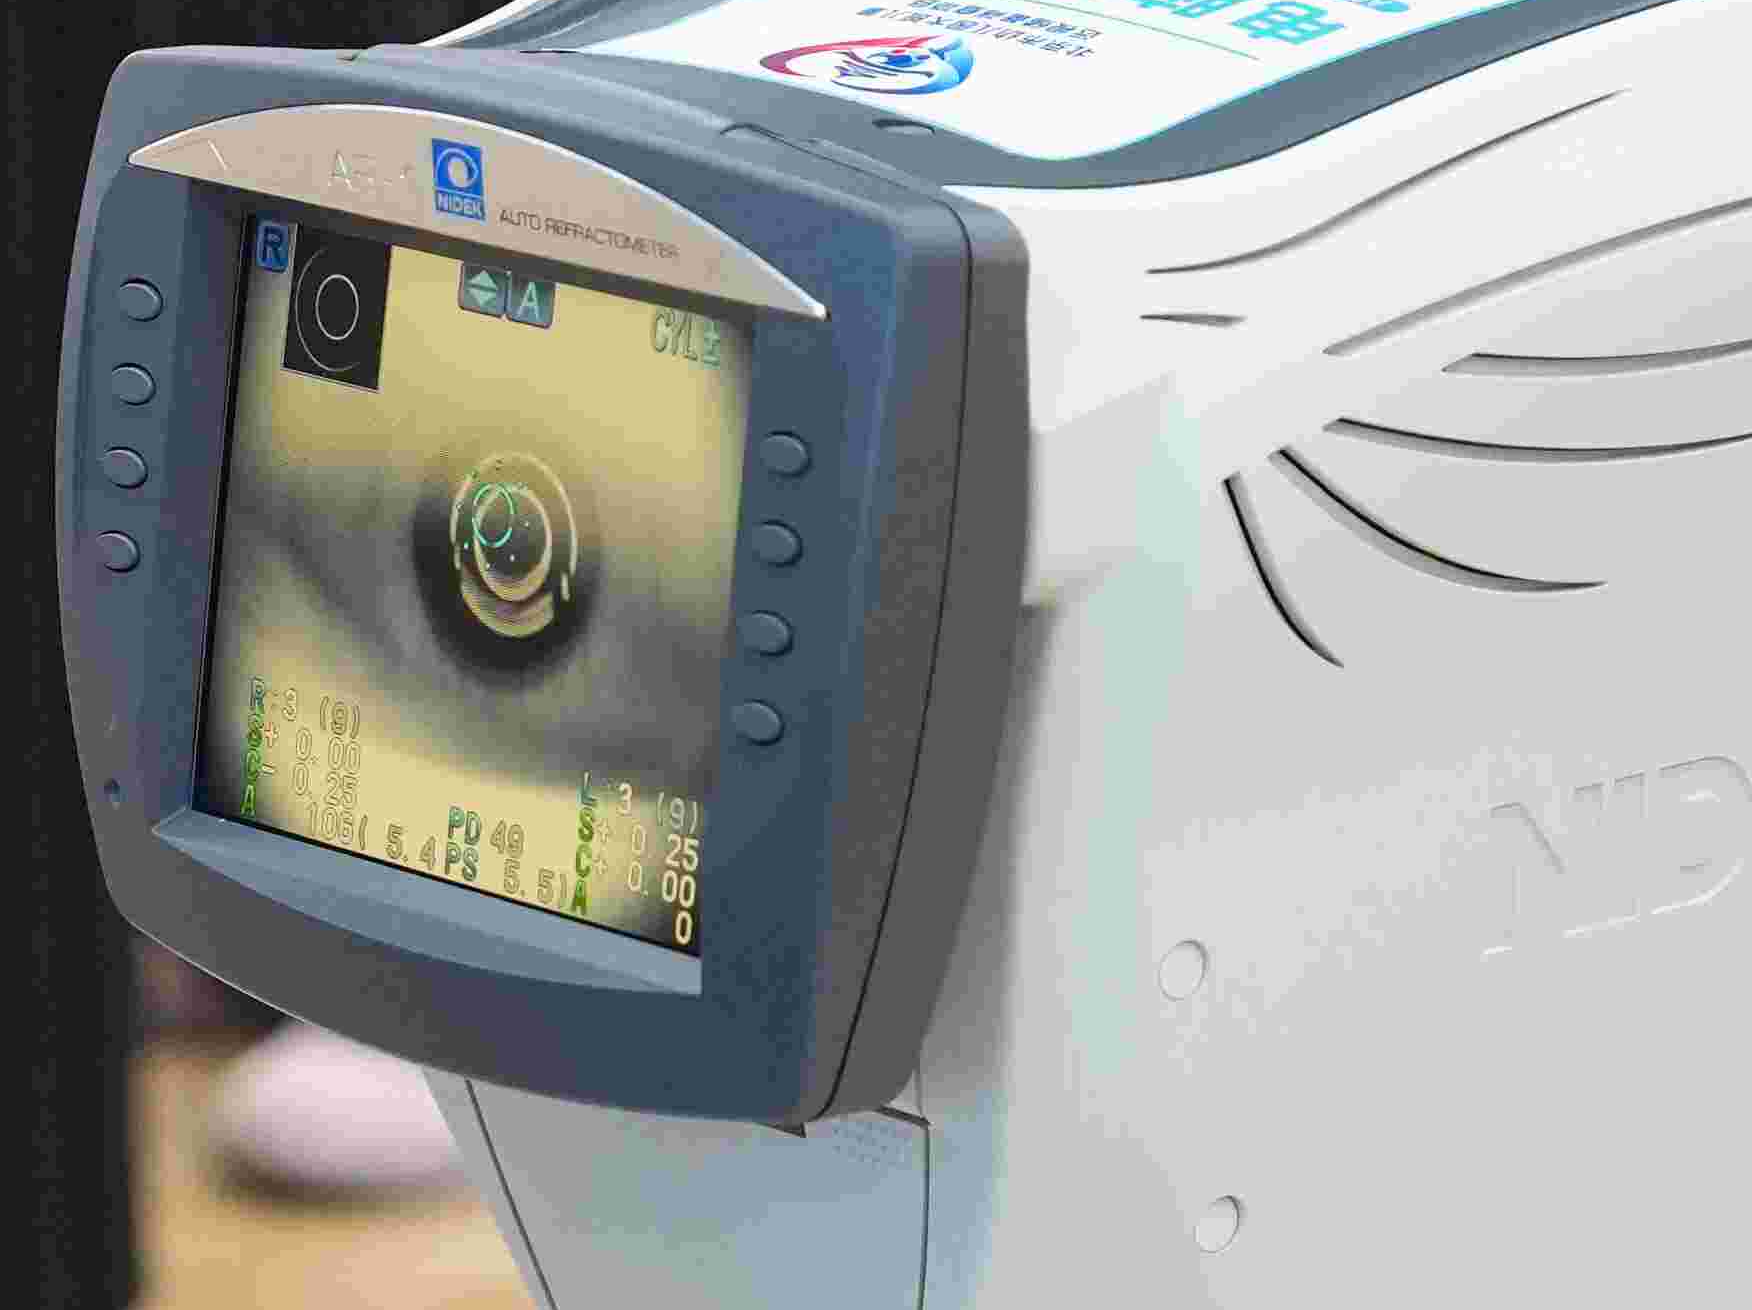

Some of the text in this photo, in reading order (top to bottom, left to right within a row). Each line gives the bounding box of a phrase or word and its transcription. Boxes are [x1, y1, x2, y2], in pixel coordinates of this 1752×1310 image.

[436, 192, 485, 220] NIDEK
[261, 226, 284, 264] R
[499, 207, 681, 261] AUTO REFRACTOMETER
[518, 280, 540, 320] A
[446, 805, 483, 846] PD
